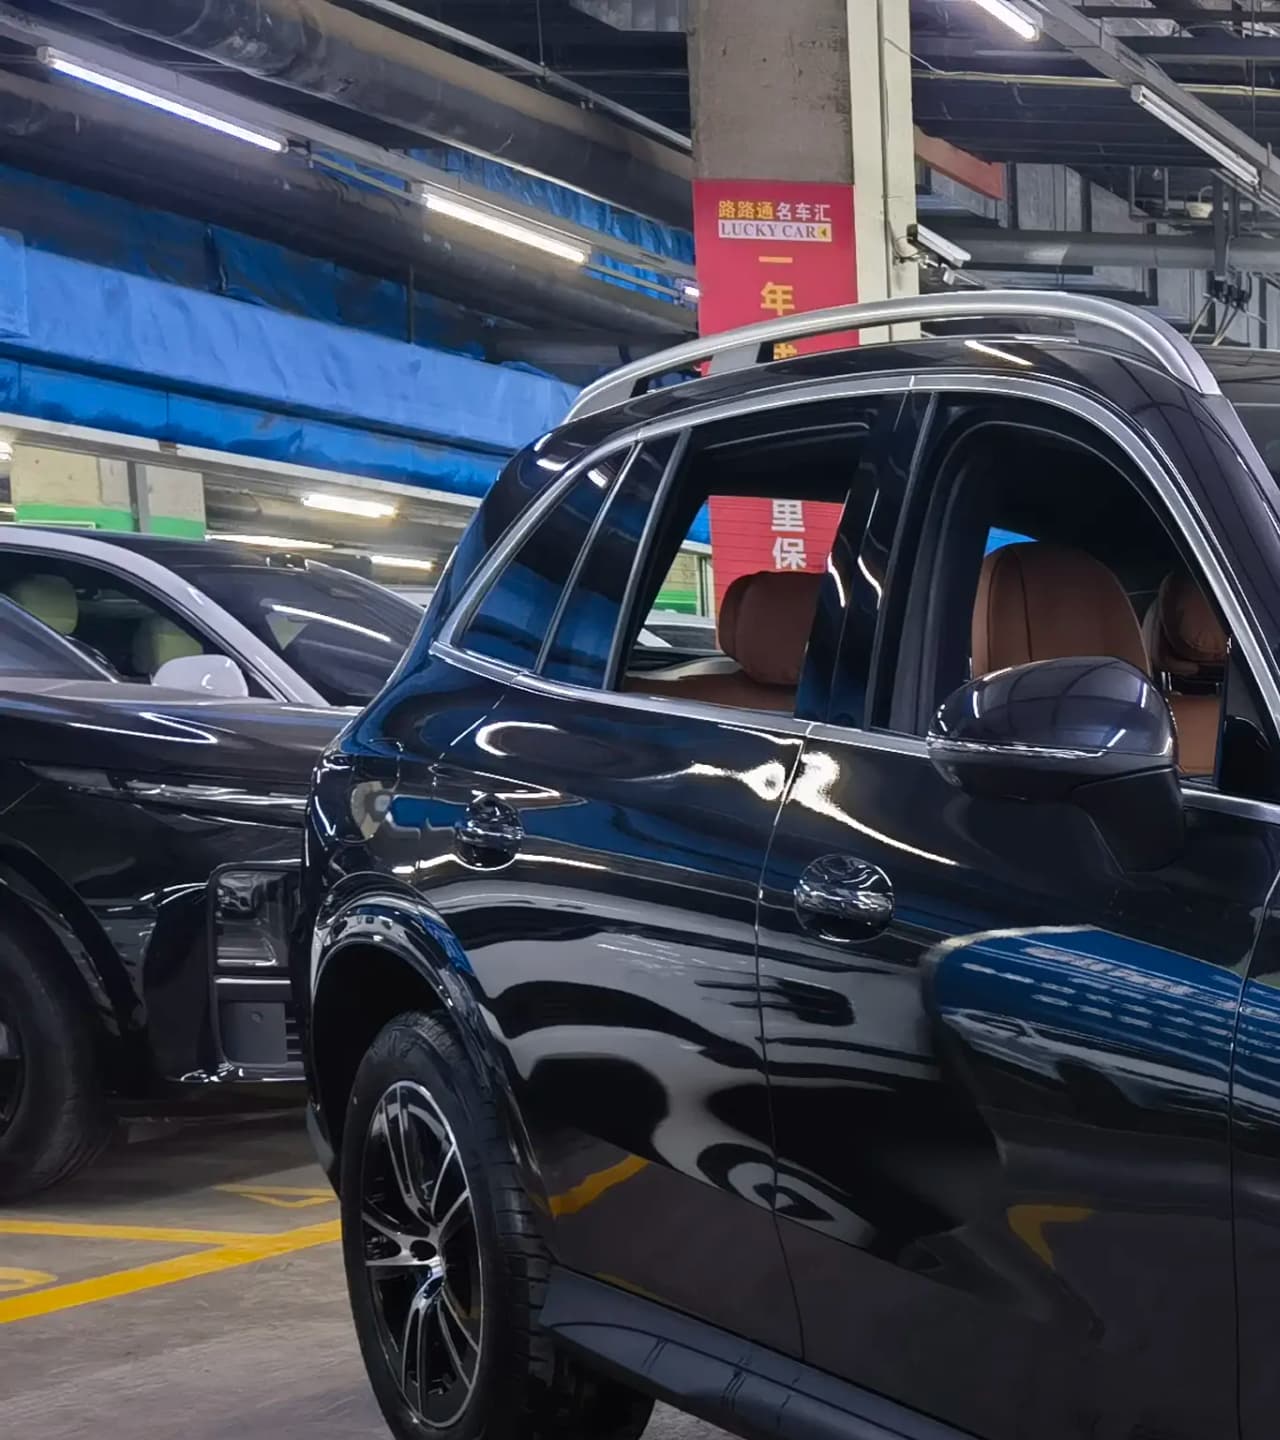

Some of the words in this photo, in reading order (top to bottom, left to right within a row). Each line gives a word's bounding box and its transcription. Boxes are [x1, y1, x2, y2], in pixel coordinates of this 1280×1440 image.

[718, 200, 832, 222] 路路通名车汇
[721, 222, 777, 237] LUCKY
[782, 226, 816, 239] CAR
